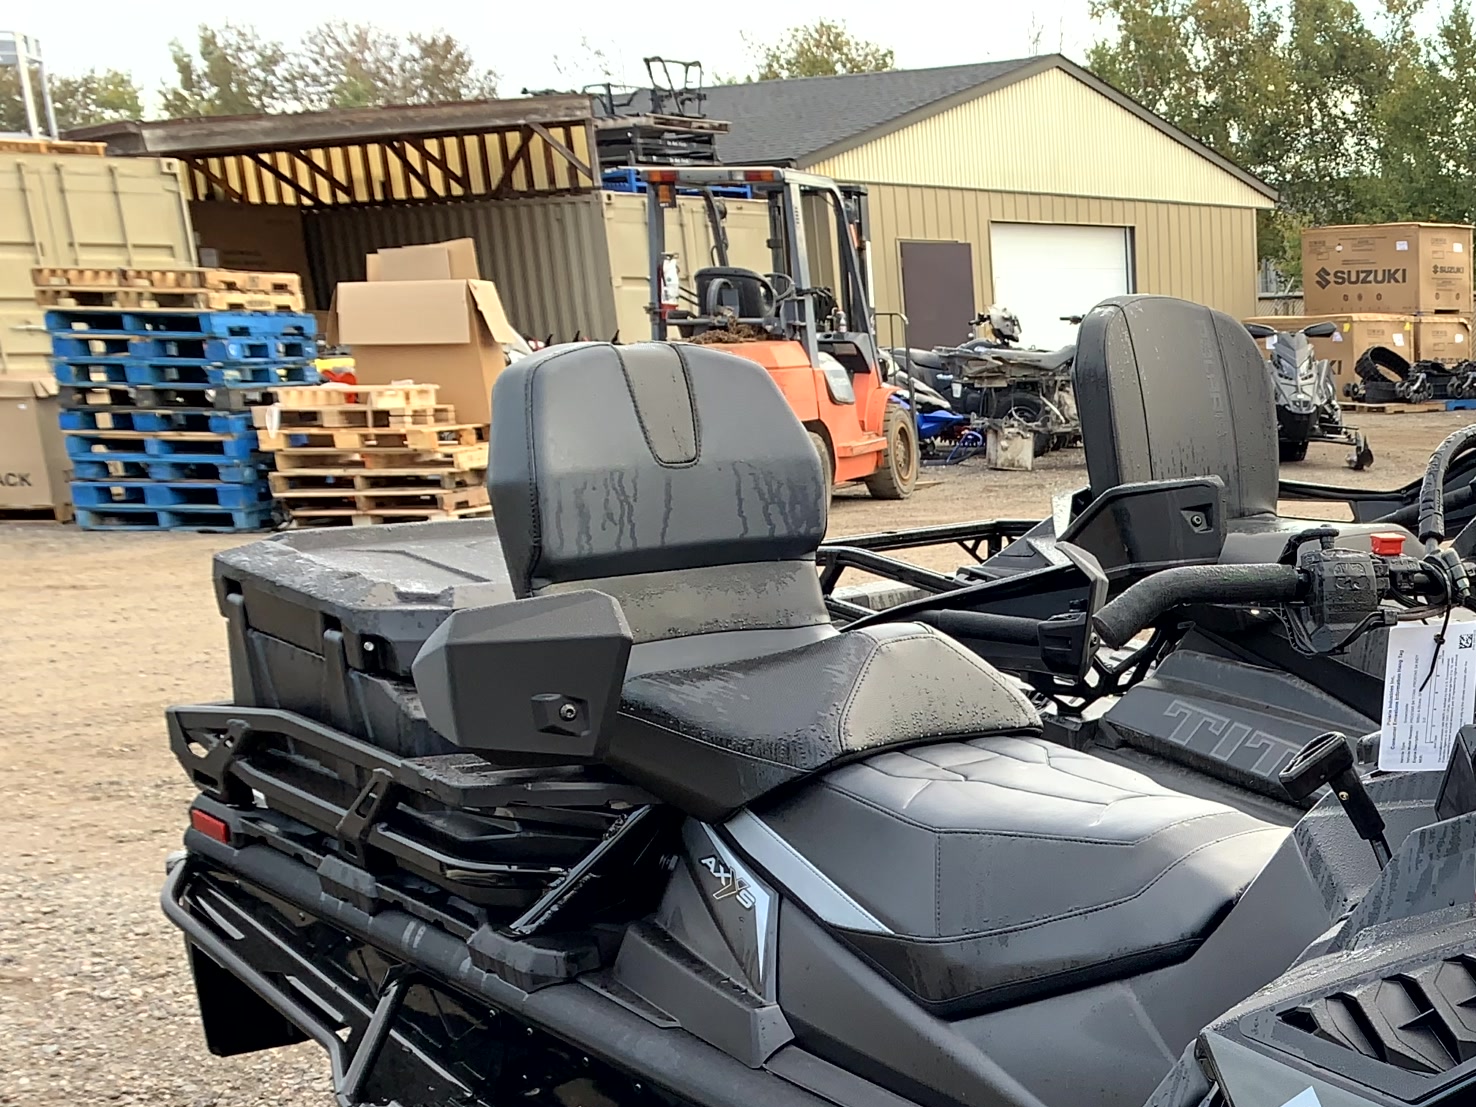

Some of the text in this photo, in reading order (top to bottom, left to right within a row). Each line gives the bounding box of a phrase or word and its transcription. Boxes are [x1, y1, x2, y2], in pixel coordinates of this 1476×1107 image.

[1333, 268, 1407, 285] SUZUKI
[1439, 266, 1464, 274] SUZUKI
[701, 857, 755, 909] AXYS
